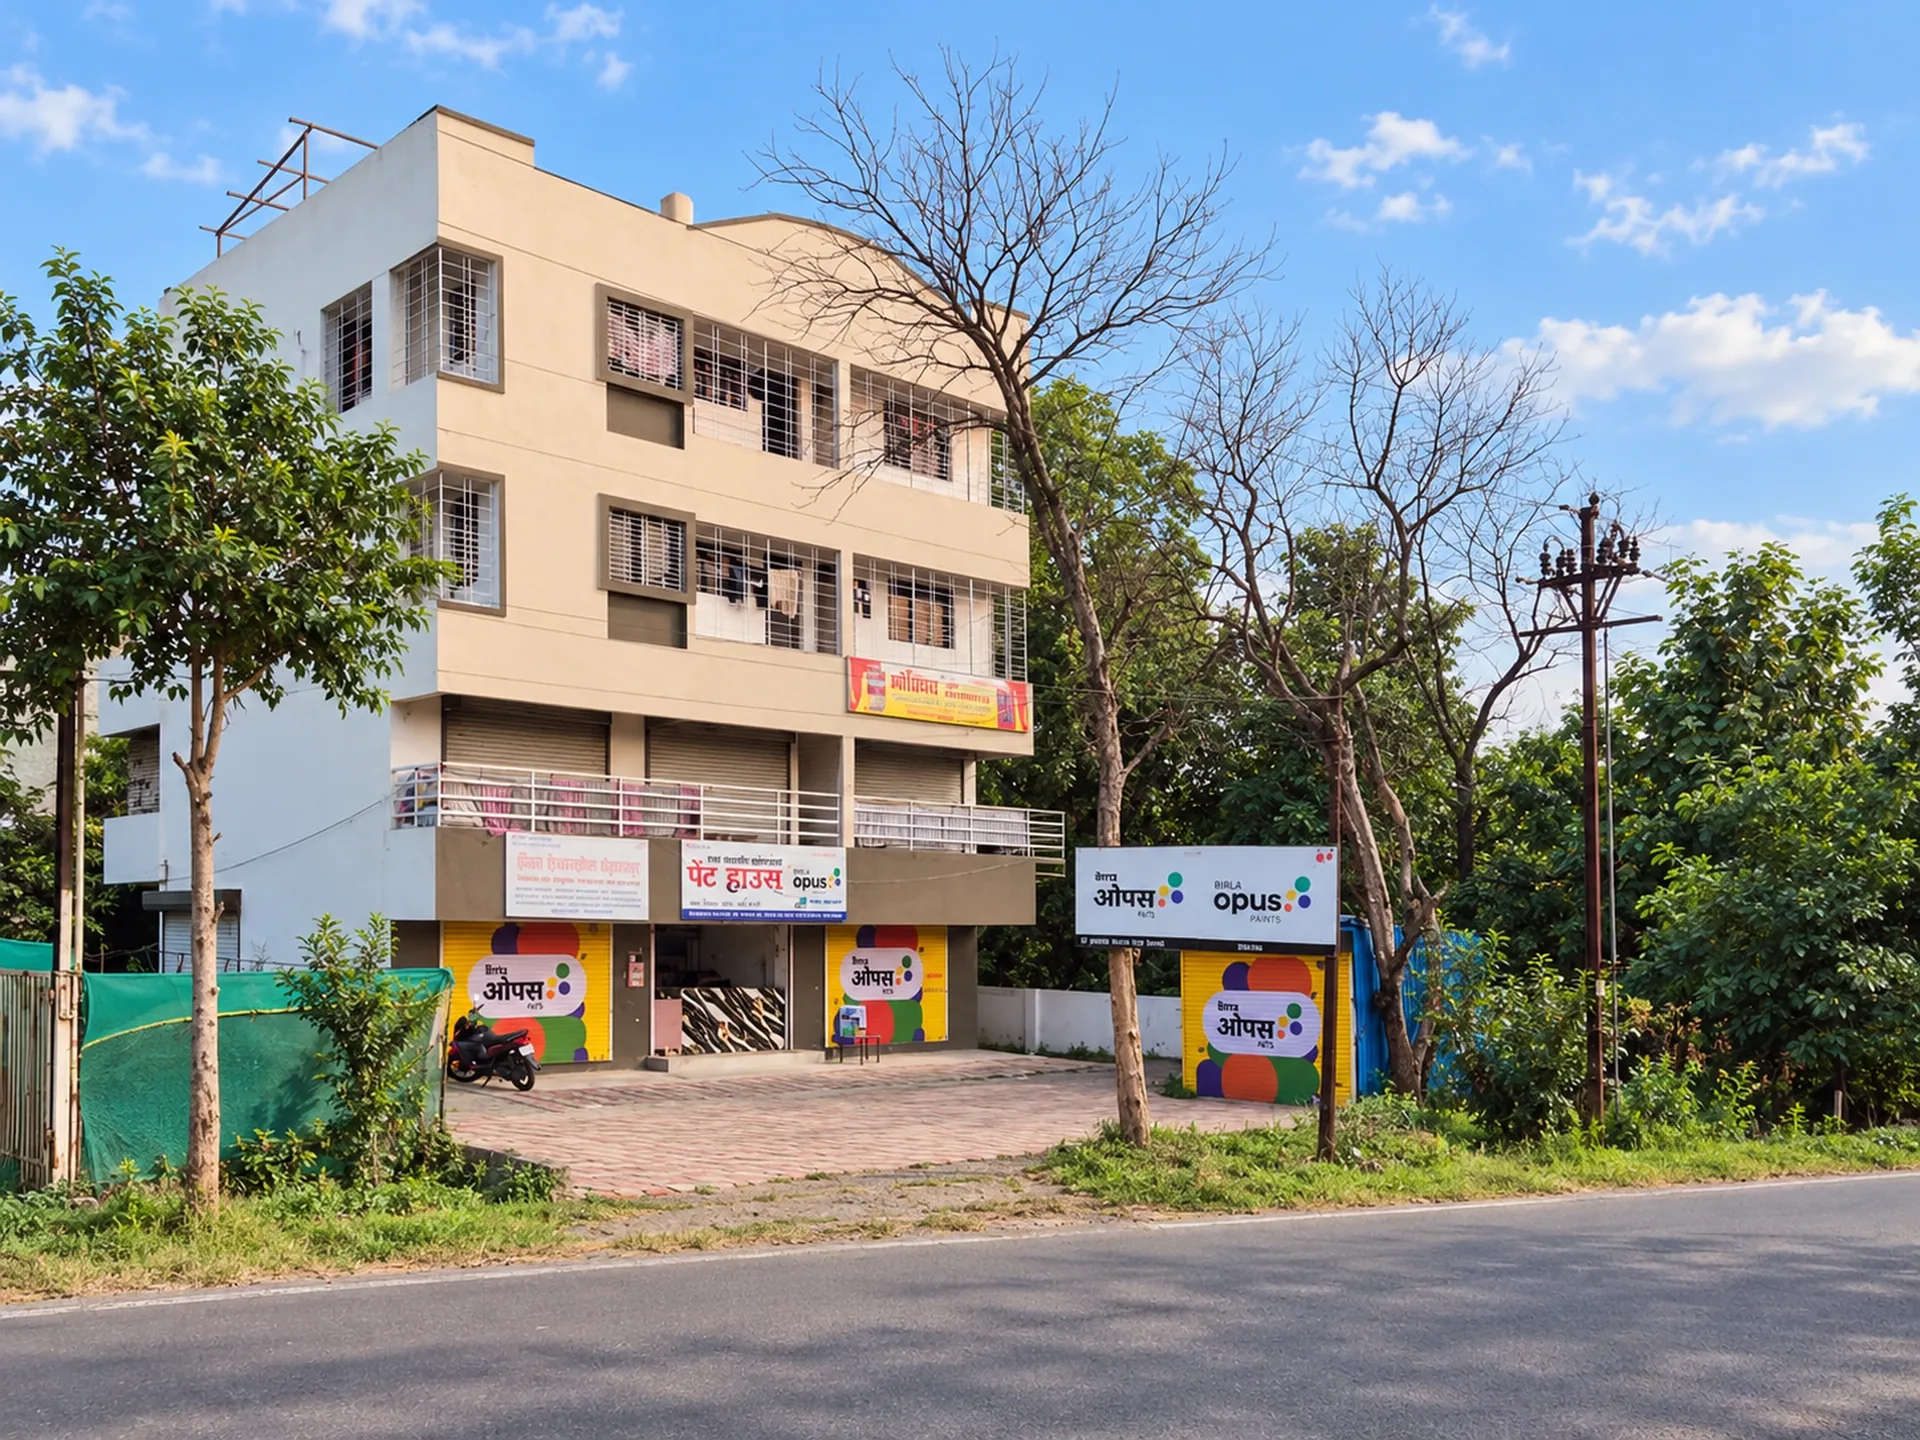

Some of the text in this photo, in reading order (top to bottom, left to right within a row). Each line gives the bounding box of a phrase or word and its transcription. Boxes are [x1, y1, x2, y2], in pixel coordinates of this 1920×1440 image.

[687, 860, 718, 888] पेंट
[725, 867, 783, 893] हाउस
[793, 876, 827, 892] opus
[1214, 880, 1242, 890] BIRLA
[1093, 883, 1156, 908] ओपस
[1213, 892, 1282, 915] opus
[1250, 915, 1282, 924] PAINTS
[851, 966, 895, 987] ओपस
[483, 976, 544, 1001] ओपस
[1217, 1013, 1275, 1040] ओपस
